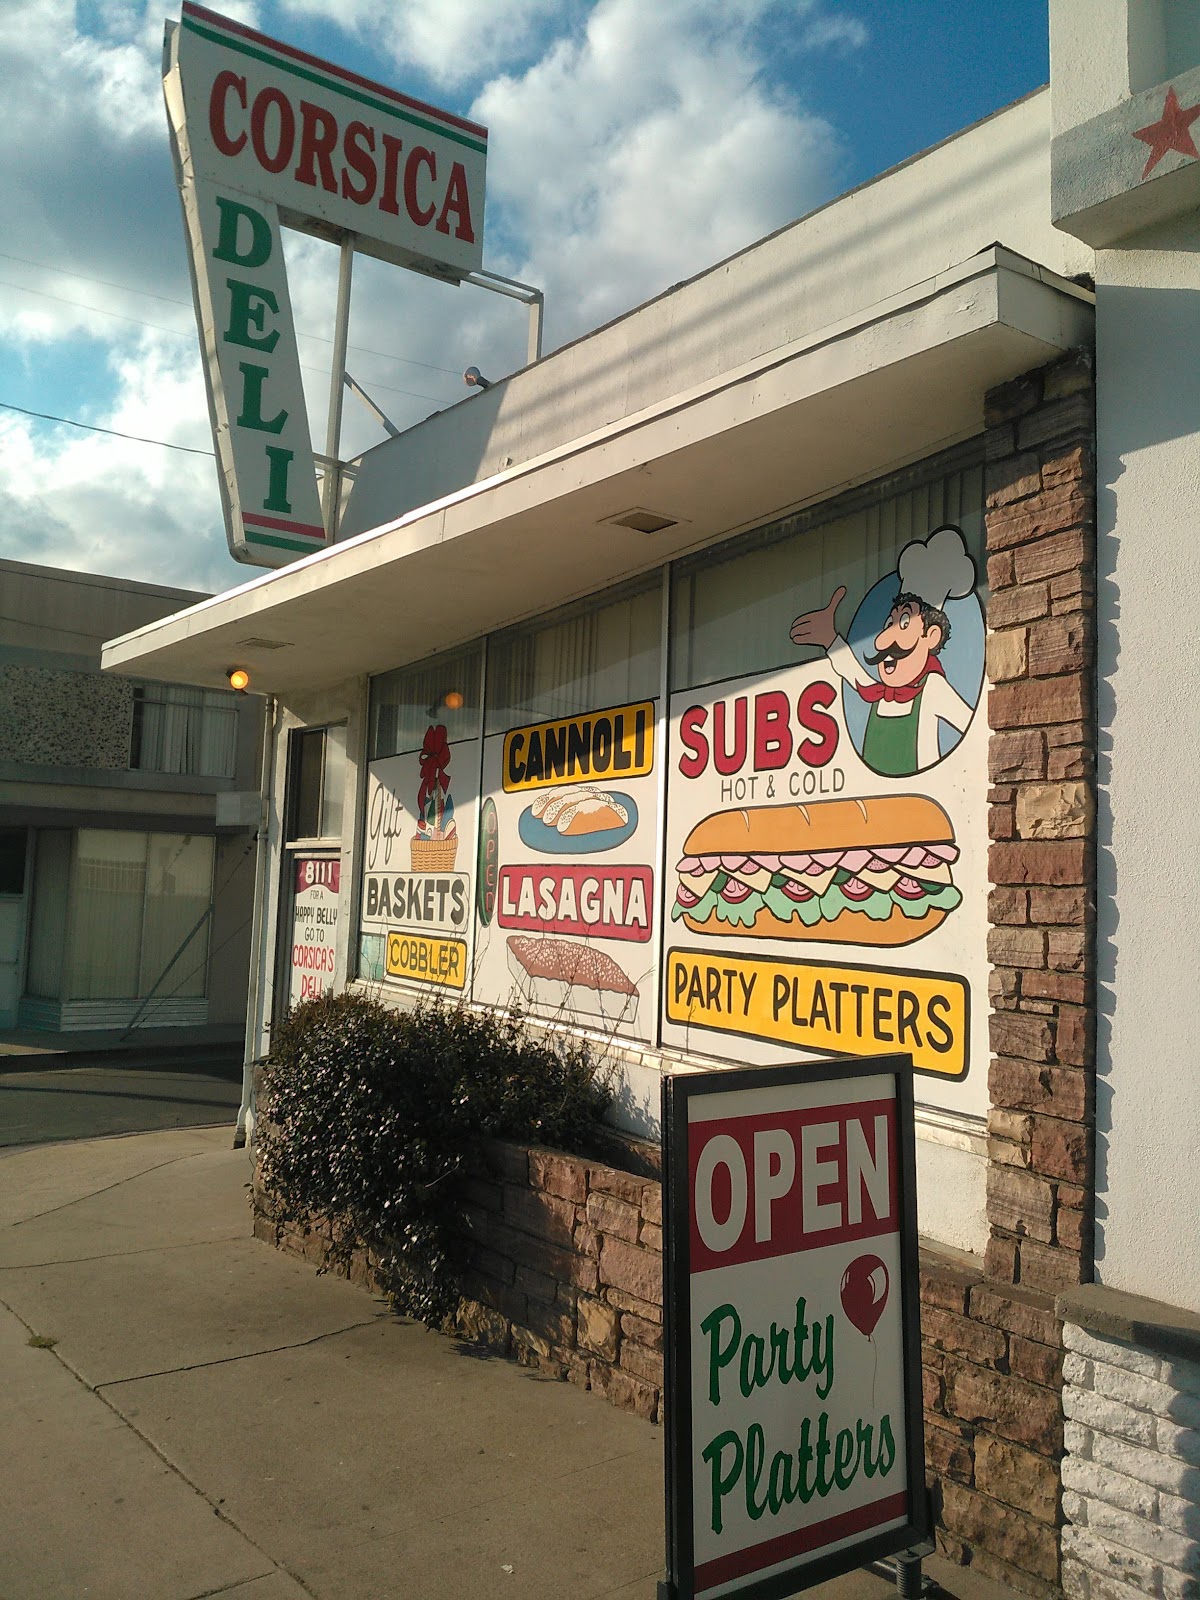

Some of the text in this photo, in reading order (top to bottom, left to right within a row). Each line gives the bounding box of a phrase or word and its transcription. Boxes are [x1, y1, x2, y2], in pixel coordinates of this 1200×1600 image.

[209, 70, 475, 244] CORSICA
[212, 196, 294, 514] DELI
[509, 709, 645, 783] CANNOLI
[678, 680, 838, 778] SUBS
[720, 767, 845, 803] HOT & COLD
[368, 782, 403, 870] Gift
[305, 861, 333, 884] 8111
[310, 890, 324, 900] FOR A
[367, 877, 464, 925] BASKETS
[503, 876, 646, 927] LASAGNA
[295, 906, 337, 926] HAPPY BELLY
[305, 927, 325, 942] GO TO
[293, 945, 334, 972] CORSICA'S
[391, 939, 459, 978] COBBLER
[675, 963, 954, 1053] PARTY PLATTERS
[694, 1114, 890, 1253] OPEN
[700, 1296, 835, 1406] Party
[702, 1412, 896, 1535] Platters
